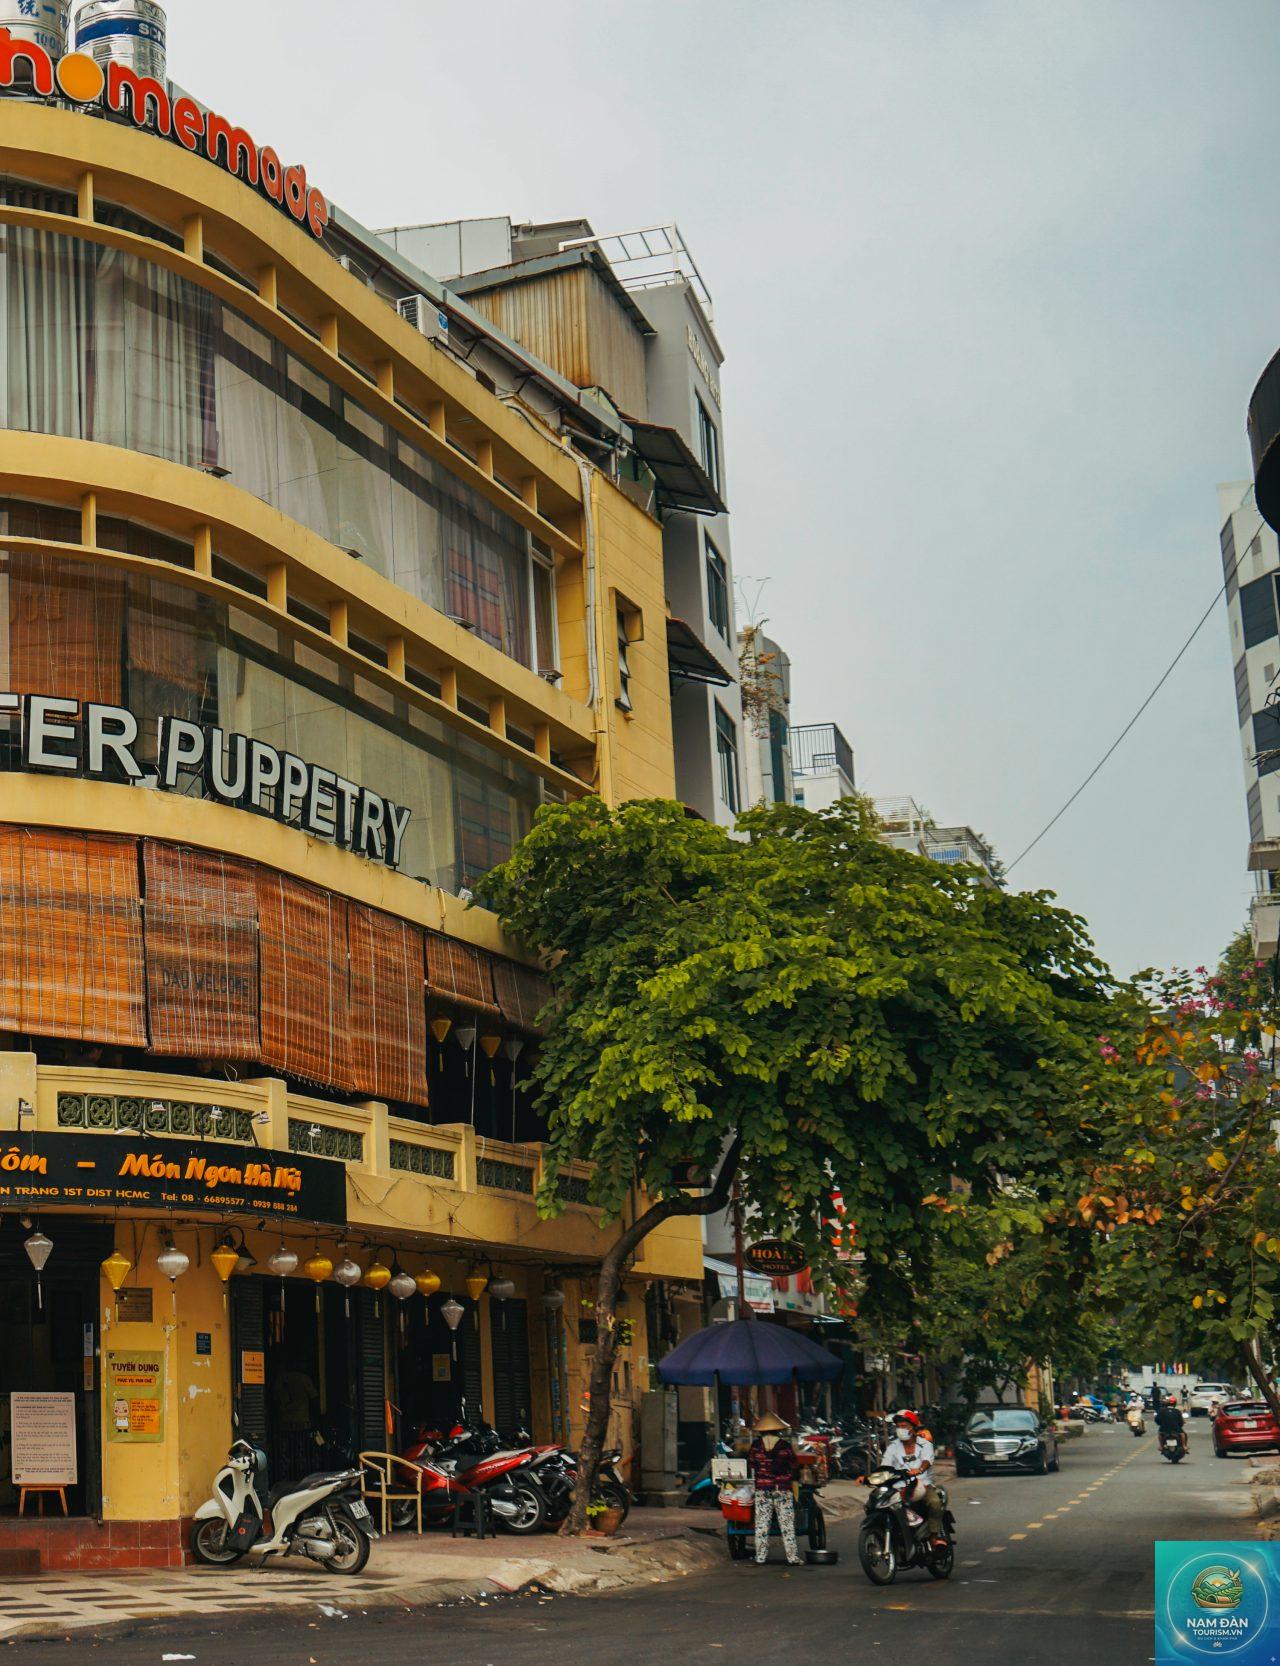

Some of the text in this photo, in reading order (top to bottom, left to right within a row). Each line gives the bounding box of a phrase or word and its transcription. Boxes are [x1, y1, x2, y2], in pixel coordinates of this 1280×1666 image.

[160, 716, 412, 866] PUPPETRY
[118, 1153, 181, 1179] Món
[185, 1157, 242, 1188] Ngon
[243, 1163, 271, 1188] Hà
[273, 1166, 302, 1197] Nội
[16, 1186, 59, 1196] TRANG
[64, 1188, 82, 1196] 1ST
[86, 1189, 112, 1197] DIST
[116, 1189, 150, 1199] HCMC
[161, 1192, 178, 1201] Tel:
[181, 1194, 194, 1202] 08
[204, 1195, 245, 1206] 66895577
[253, 1200, 271, 1209] 0939
[751, 1247, 804, 1260] HOÀ
